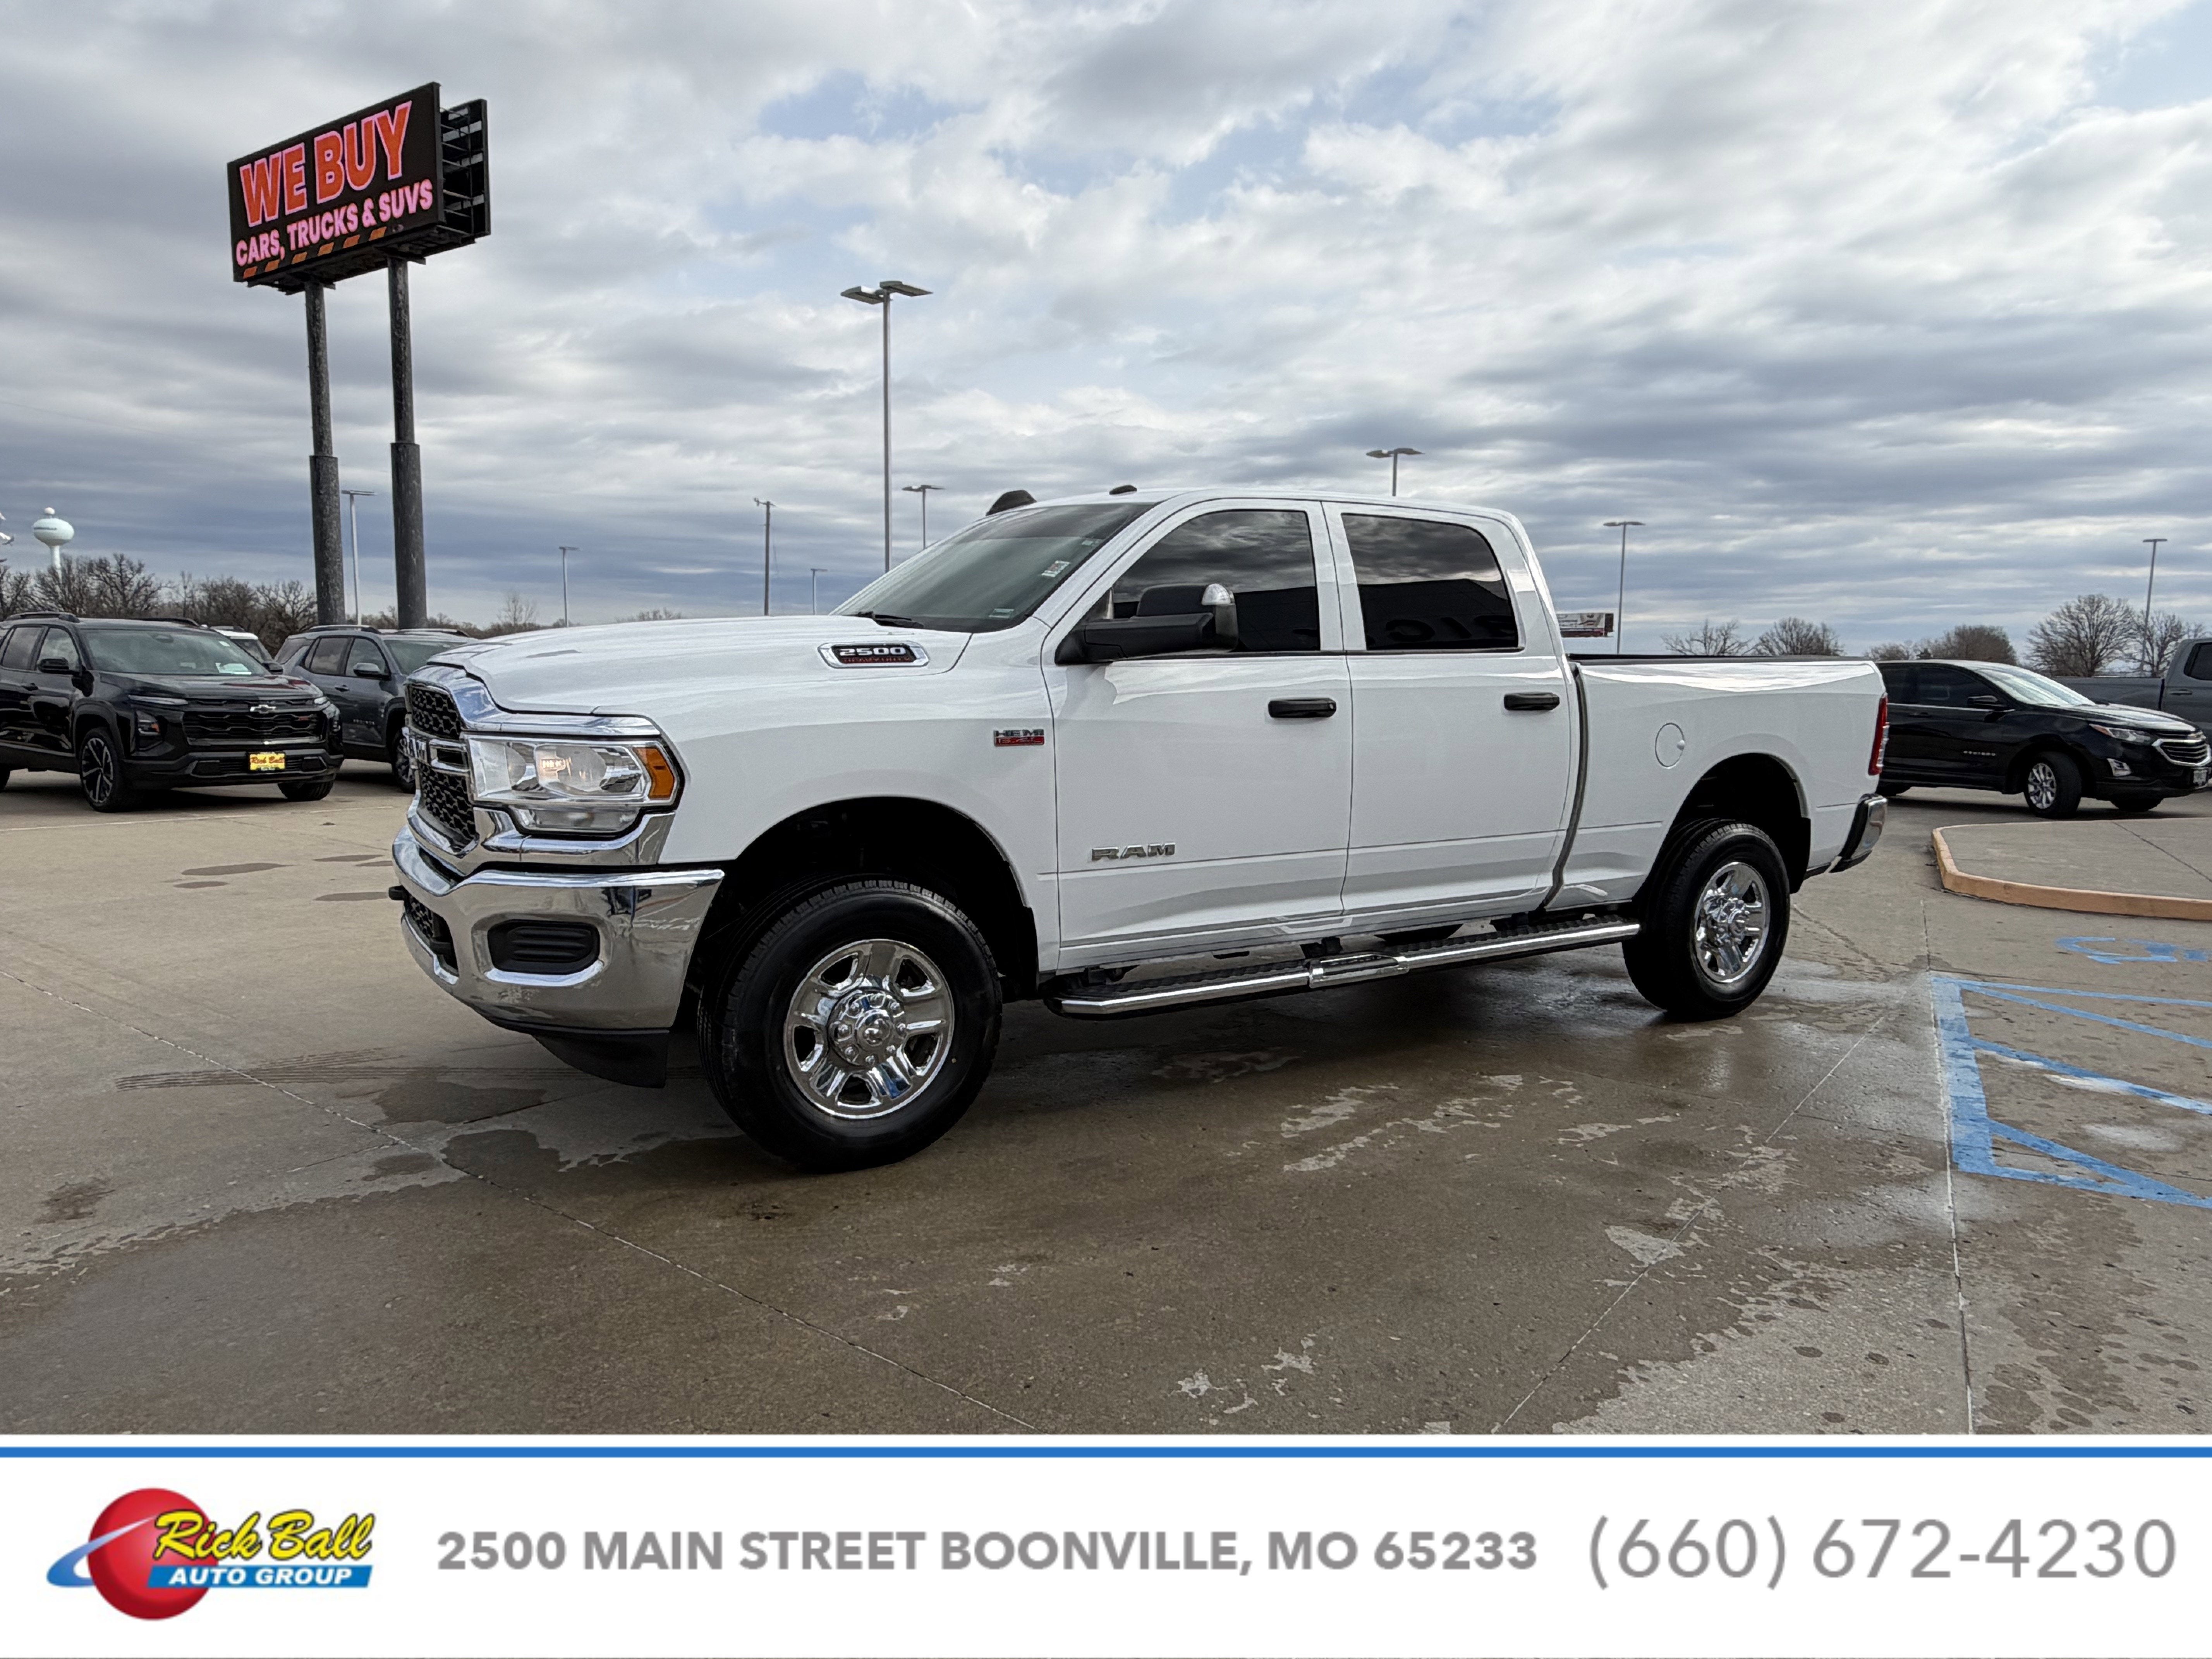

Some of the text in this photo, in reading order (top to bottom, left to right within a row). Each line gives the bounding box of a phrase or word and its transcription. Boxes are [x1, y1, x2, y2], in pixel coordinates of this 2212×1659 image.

[239, 100, 412, 228] WE BUY
[236, 179, 433, 266] CARS, TRUCKS & SUVS
[839, 647, 907, 656] 2500
[1091, 842, 1176, 861] RAM
